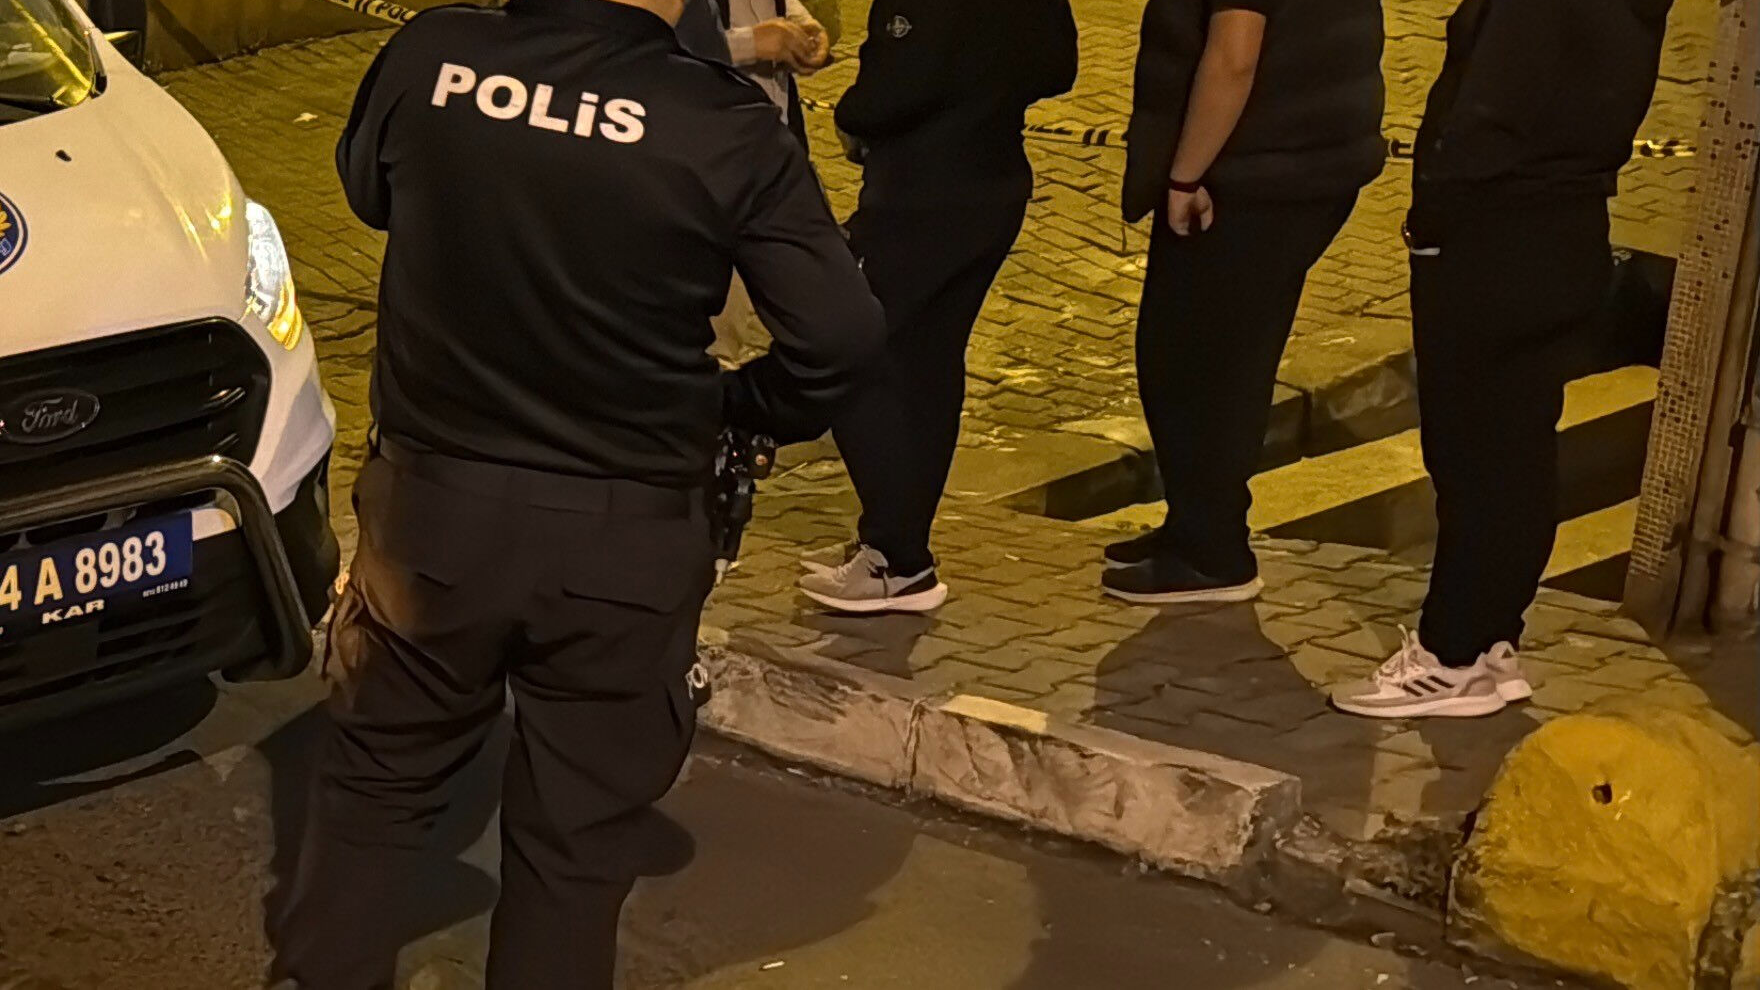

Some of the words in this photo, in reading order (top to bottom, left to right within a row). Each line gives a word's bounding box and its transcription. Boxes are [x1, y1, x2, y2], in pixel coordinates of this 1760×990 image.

[21, 397, 78, 433] Ford
[34, 557, 63, 606] A
[74, 530, 167, 594] 8983
[41, 599, 106, 625] KAR
